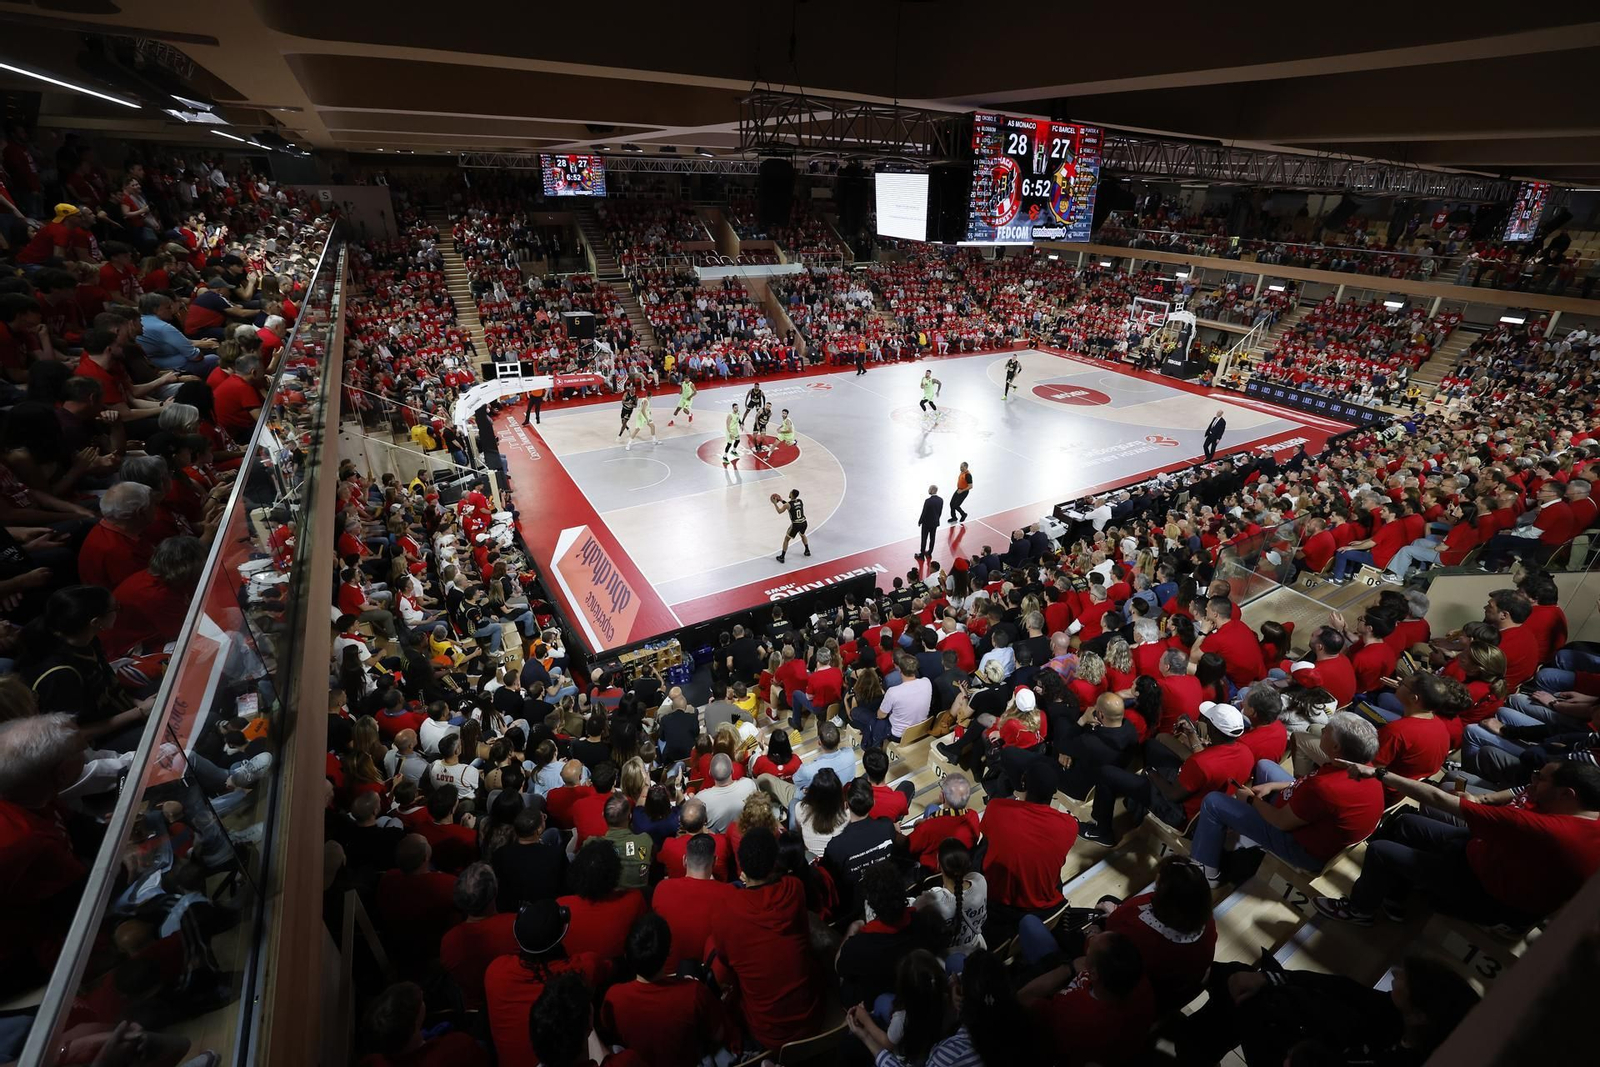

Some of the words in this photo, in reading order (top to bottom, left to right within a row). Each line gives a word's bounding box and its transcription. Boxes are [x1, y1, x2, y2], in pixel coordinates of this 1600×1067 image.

[1015, 121, 1036, 129] MONACO
[1059, 126, 1075, 134] BARCEL
[1007, 133, 1028, 156] 28
[1051, 138, 1070, 158] 27
[1022, 179, 1050, 197] 6:52
[997, 226, 1028, 239] FEDCOM
[574, 317, 580, 326] 6
[585, 591, 615, 642] experience
[436, 774, 454, 782] LOYD
[1282, 882, 1310, 908] 12
[1462, 944, 1502, 980] 13
